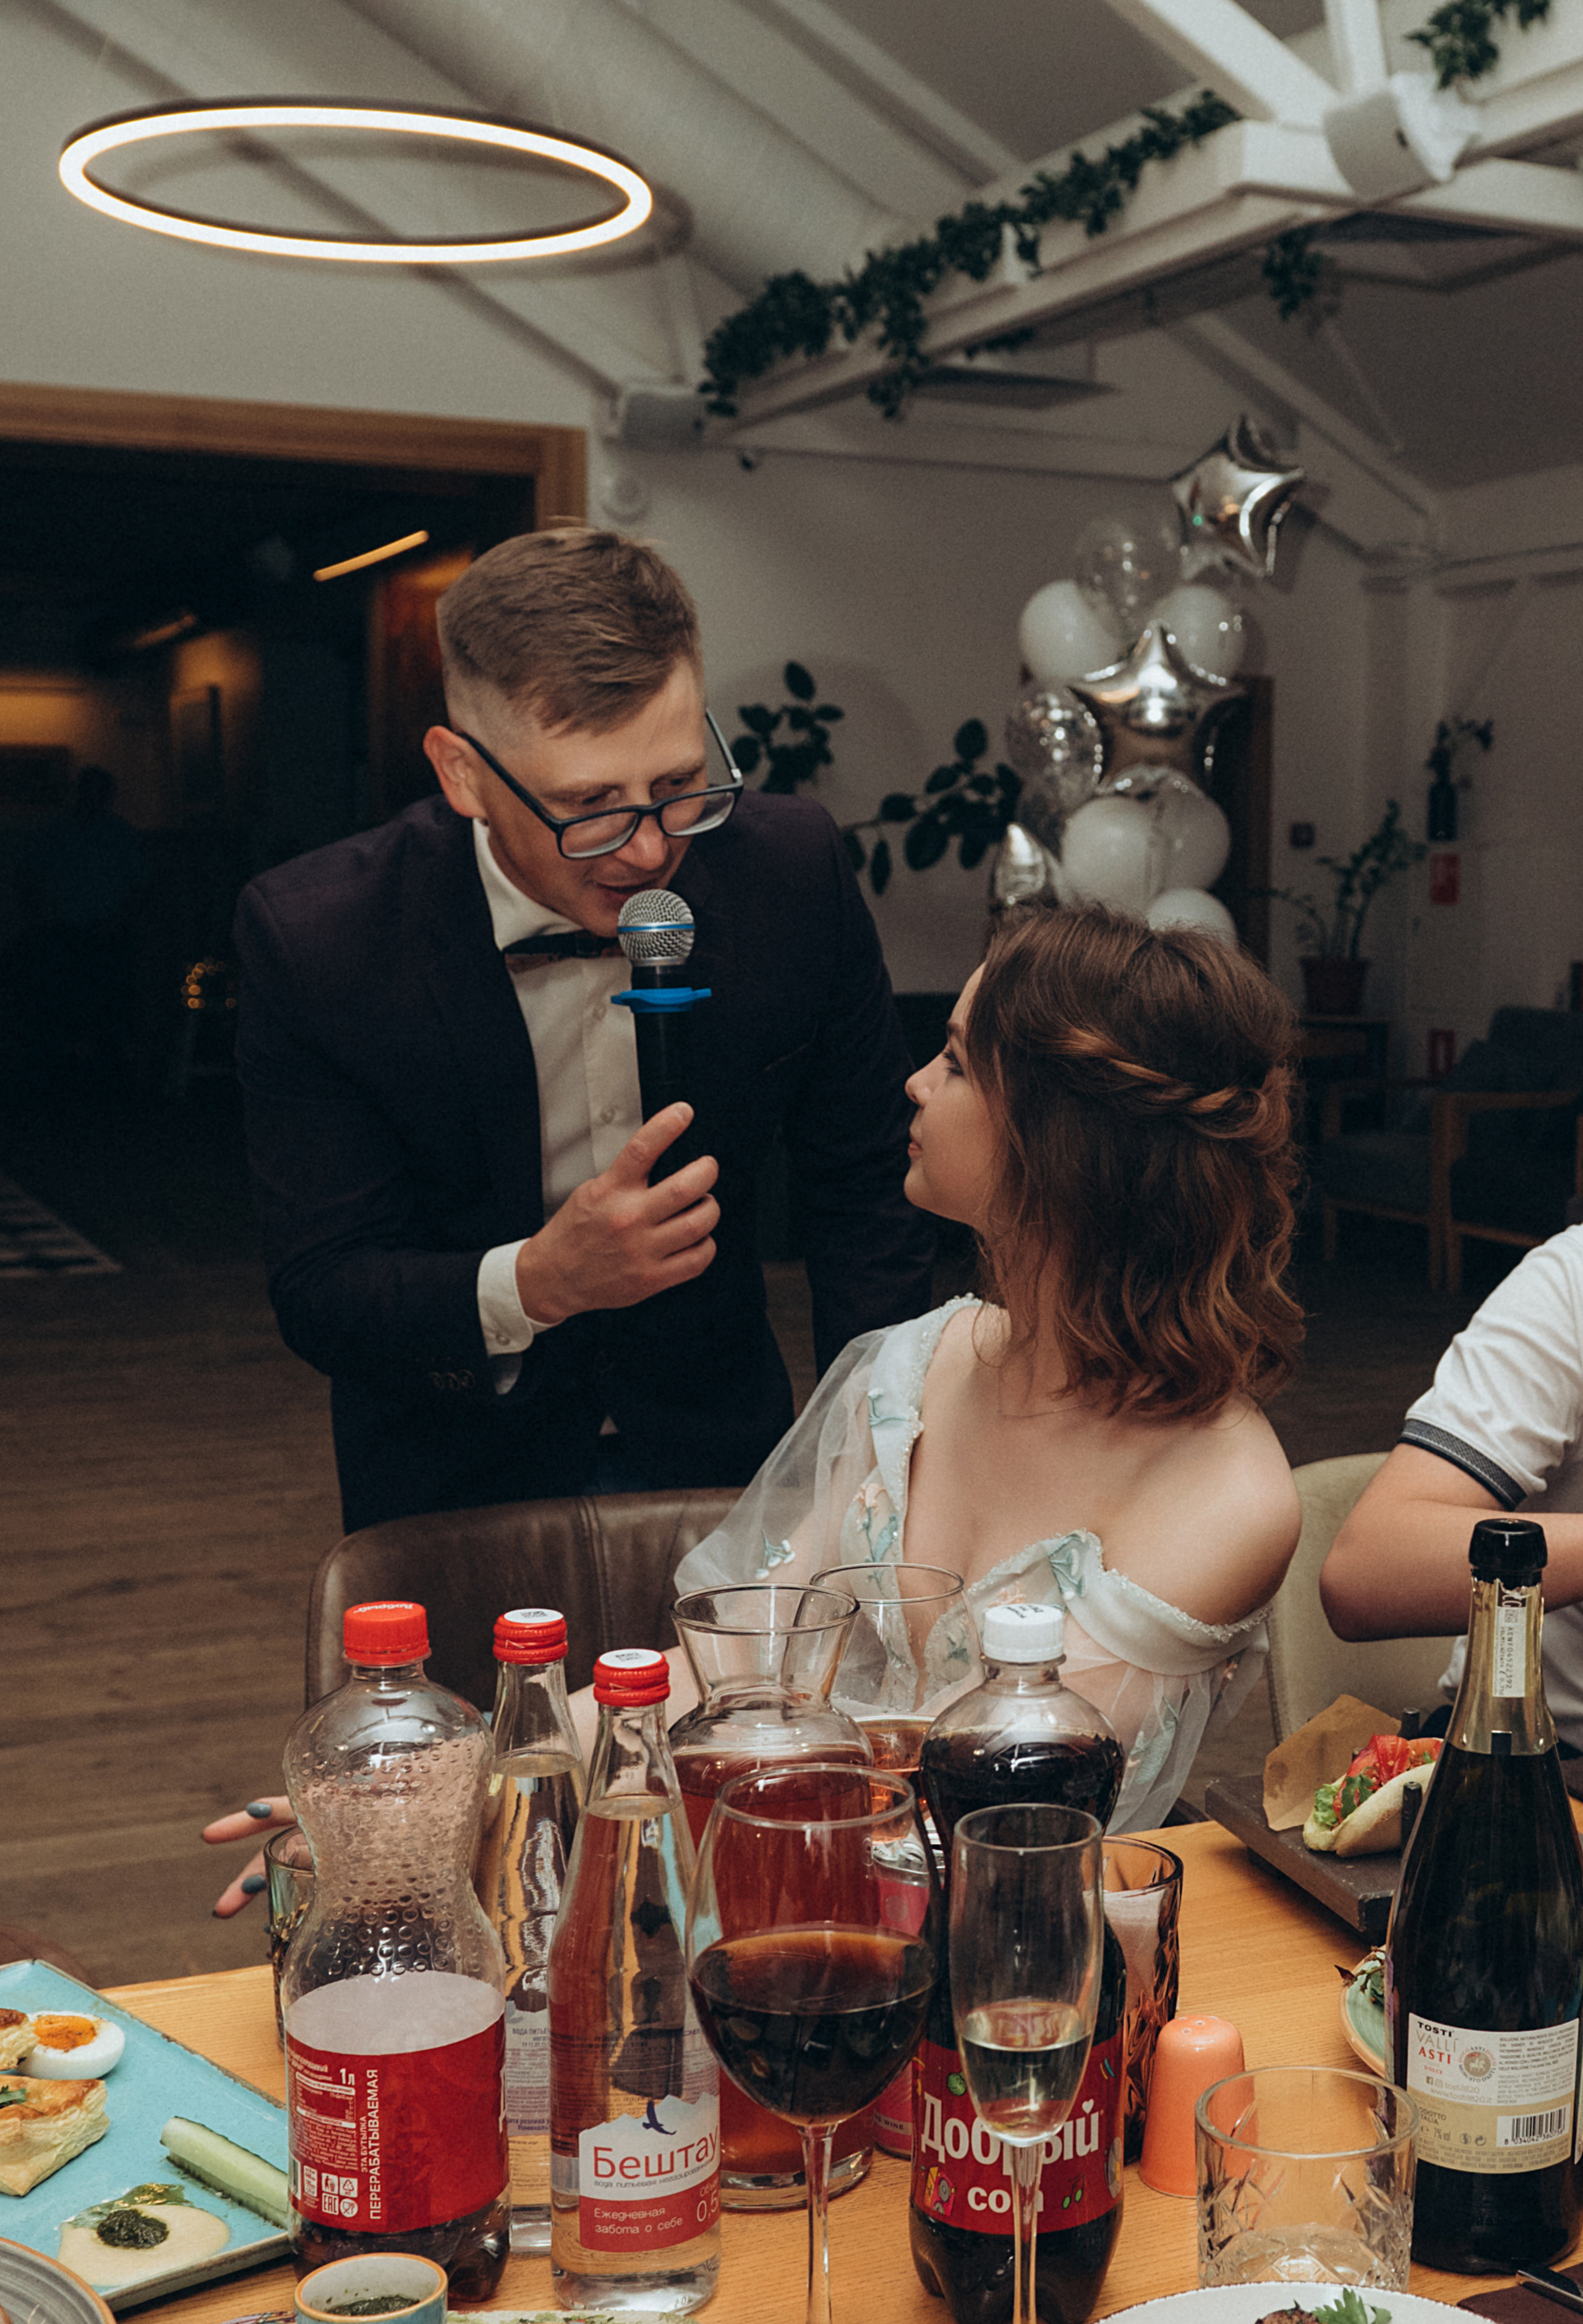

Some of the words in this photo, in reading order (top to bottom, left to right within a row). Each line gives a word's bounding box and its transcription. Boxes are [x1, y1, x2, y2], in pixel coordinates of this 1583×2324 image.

[1417, 2021, 1452, 2038] TOSTI
[1419, 2046, 1451, 2065] ASTI
[1424, 2065, 1443, 2075] DOLCE
[1444, 2082, 1480, 2095] tosti1820
[884, 2119, 904, 2130] WINE
[359, 2115, 368, 2156] БУТЫЛКА
[366, 2069, 382, 2219] ПЕРЕРАБАТЫВАЕМАЯ
[594, 2125, 718, 2179] Бештау
[361, 2156, 369, 2173] ЭТА
[594, 2180, 613, 2189] вода
[616, 2179, 657, 2189] питьевая
[594, 2207, 665, 2222] Ежедневная
[594, 2223, 640, 2234] забота
[645, 2224, 652, 2233] о
[657, 2216, 683, 2231] себе
